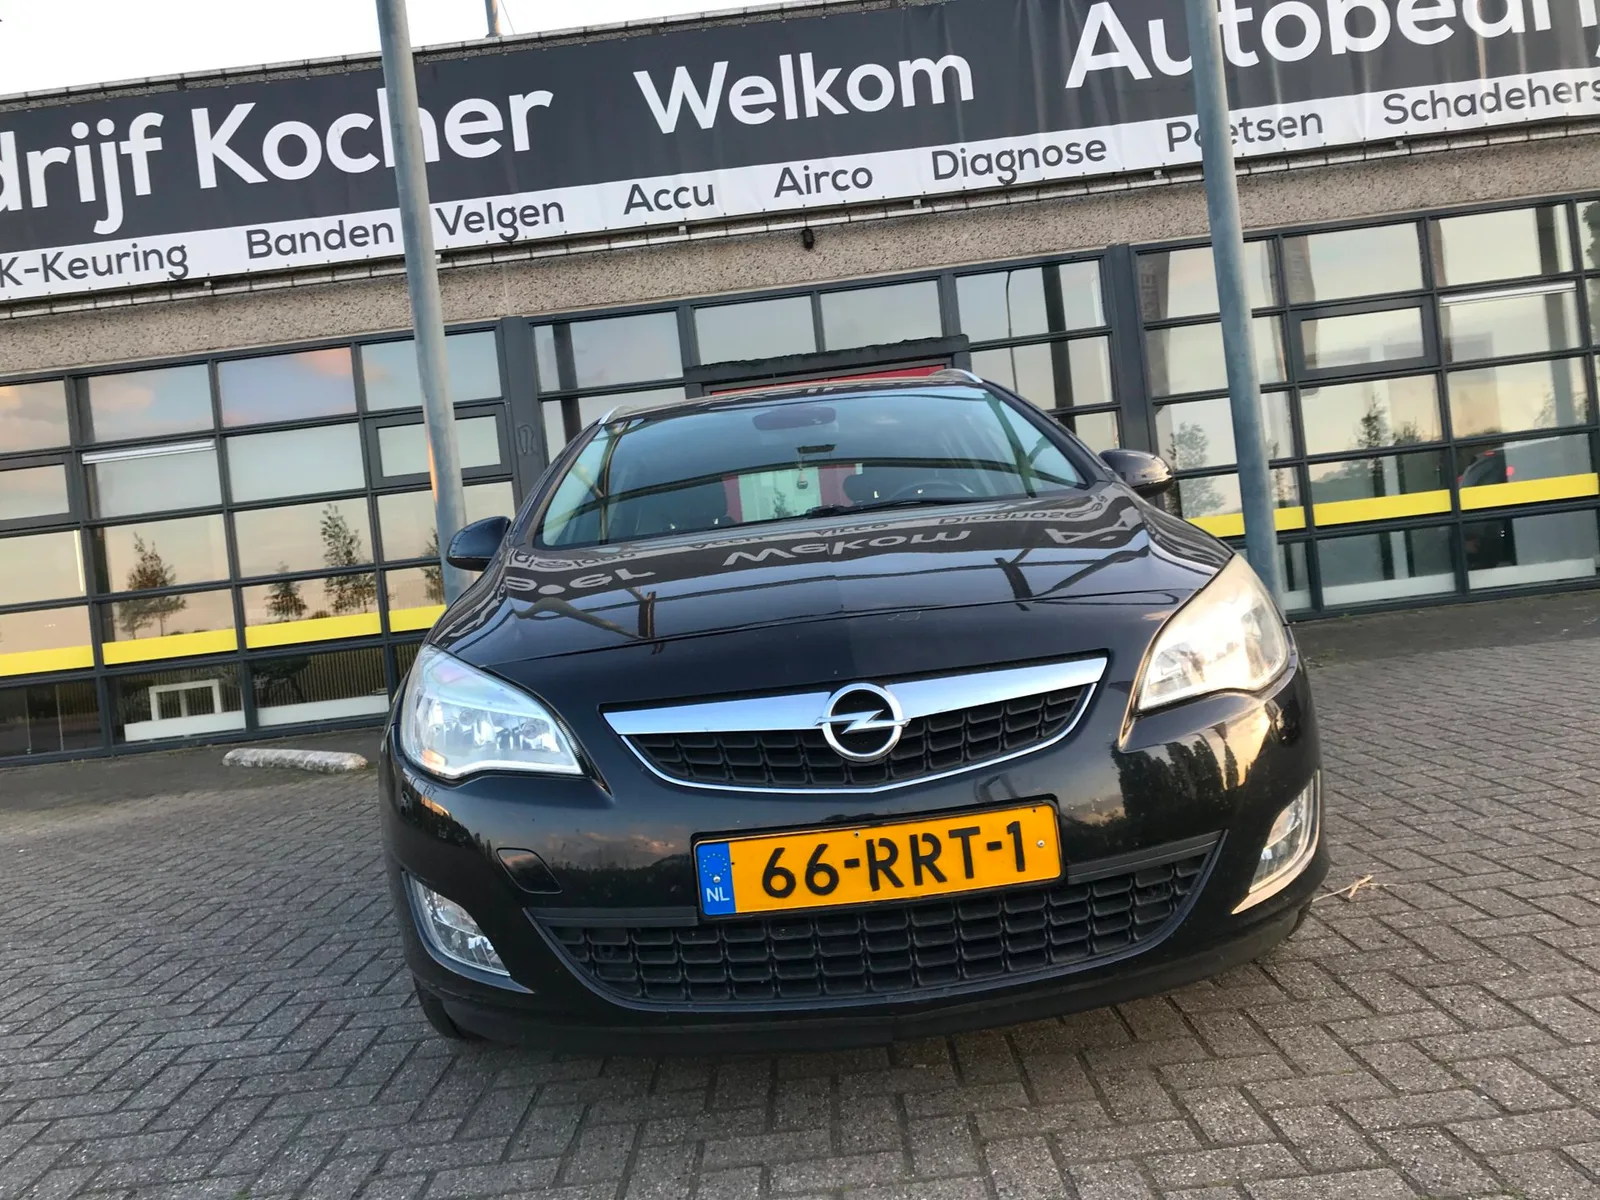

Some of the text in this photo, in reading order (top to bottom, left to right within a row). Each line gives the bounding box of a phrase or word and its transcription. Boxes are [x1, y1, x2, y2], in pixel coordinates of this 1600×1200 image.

[192, 88, 553, 189] Kocher
[633, 52, 973, 134] Welkom
[1065, 0, 1600, 89] Autobe
[0, 243, 189, 288] K-Keuring
[246, 219, 394, 259] Banden
[435, 201, 565, 241] Velgen
[623, 183, 715, 215] Accu
[774, 166, 873, 198] Airco
[932, 140, 1107, 184] Diagnose
[706, 887, 730, 903] NL
[762, 820, 1026, 898] 66-RRT-1
